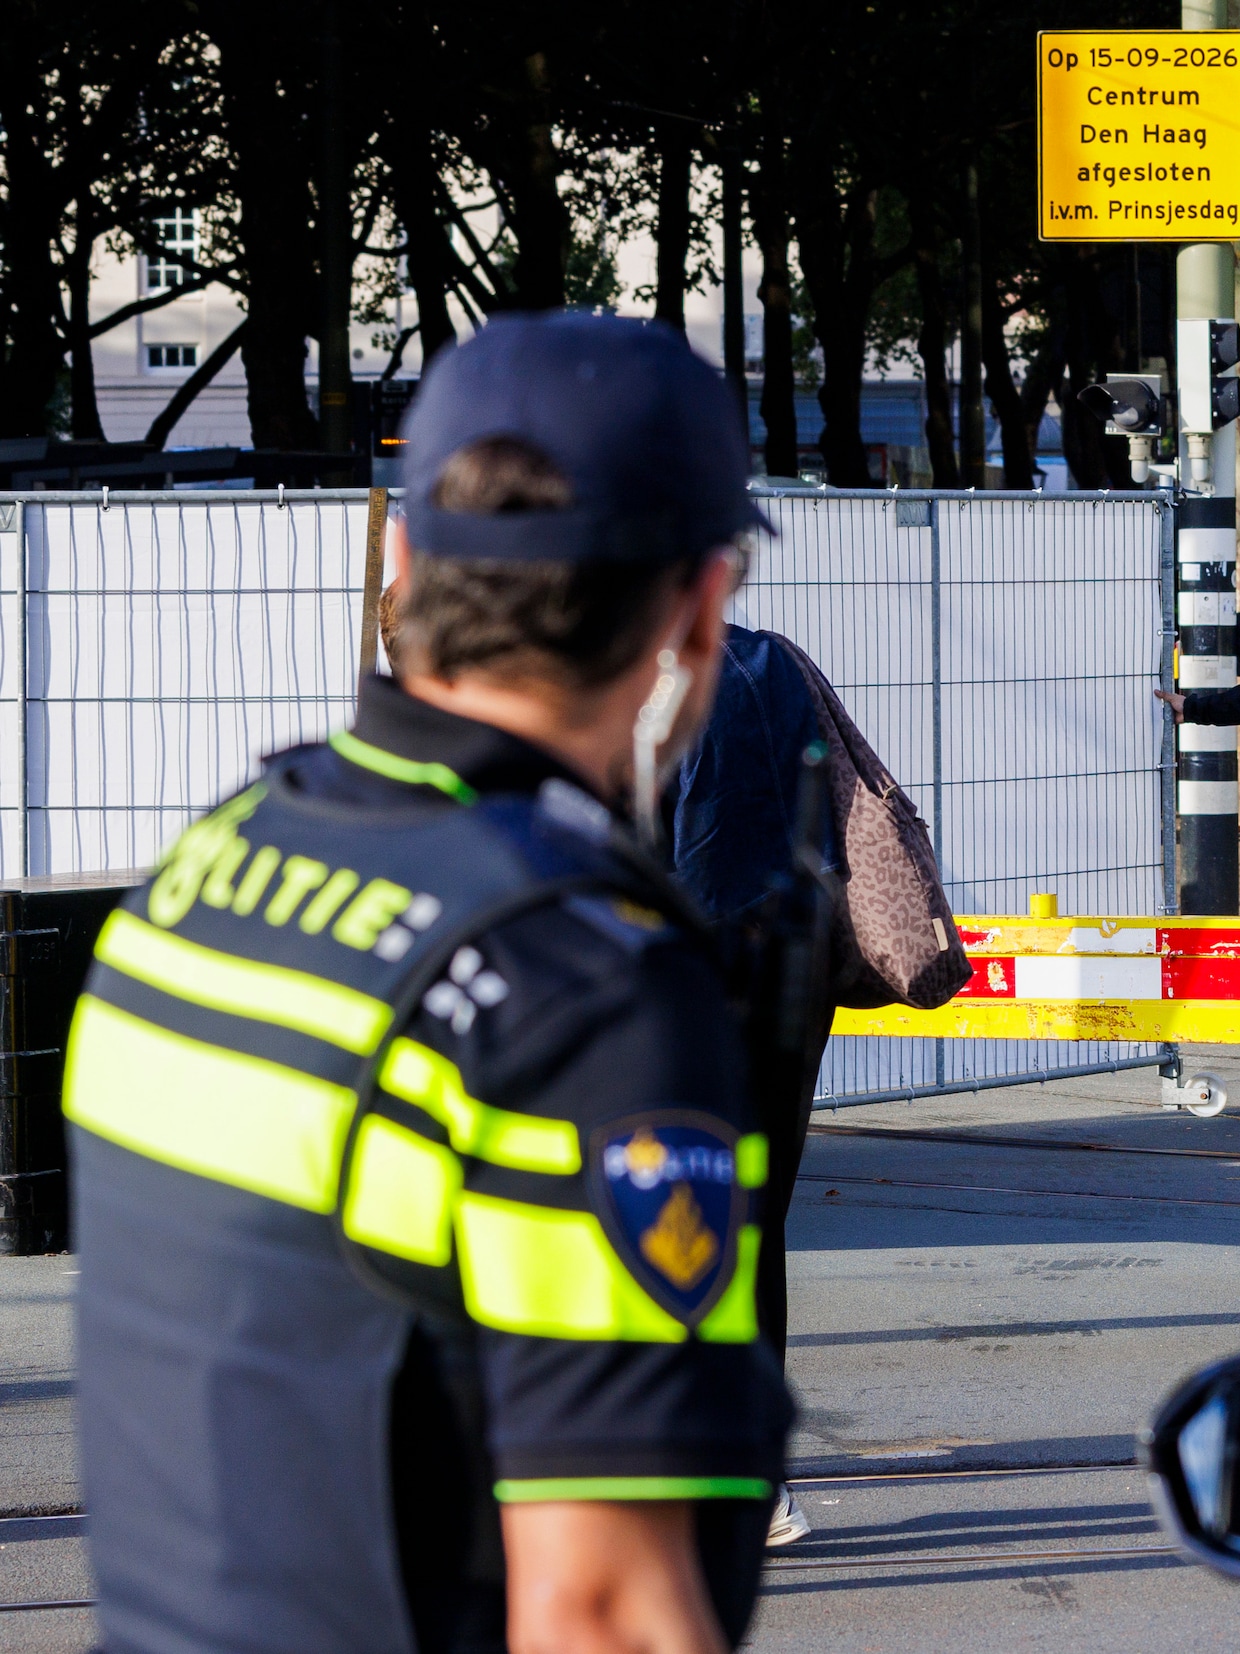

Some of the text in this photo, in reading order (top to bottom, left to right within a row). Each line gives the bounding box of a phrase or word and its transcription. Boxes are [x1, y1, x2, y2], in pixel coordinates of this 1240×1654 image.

[1047, 47, 1238, 72] Op 15-09-2026
[1087, 86, 1200, 106] Centrum
[1080, 124, 1207, 150] Den Haag
[1077, 162, 1211, 188] afgesloten
[1049, 199, 1238, 226] i.v.m. Prinsjesdag
